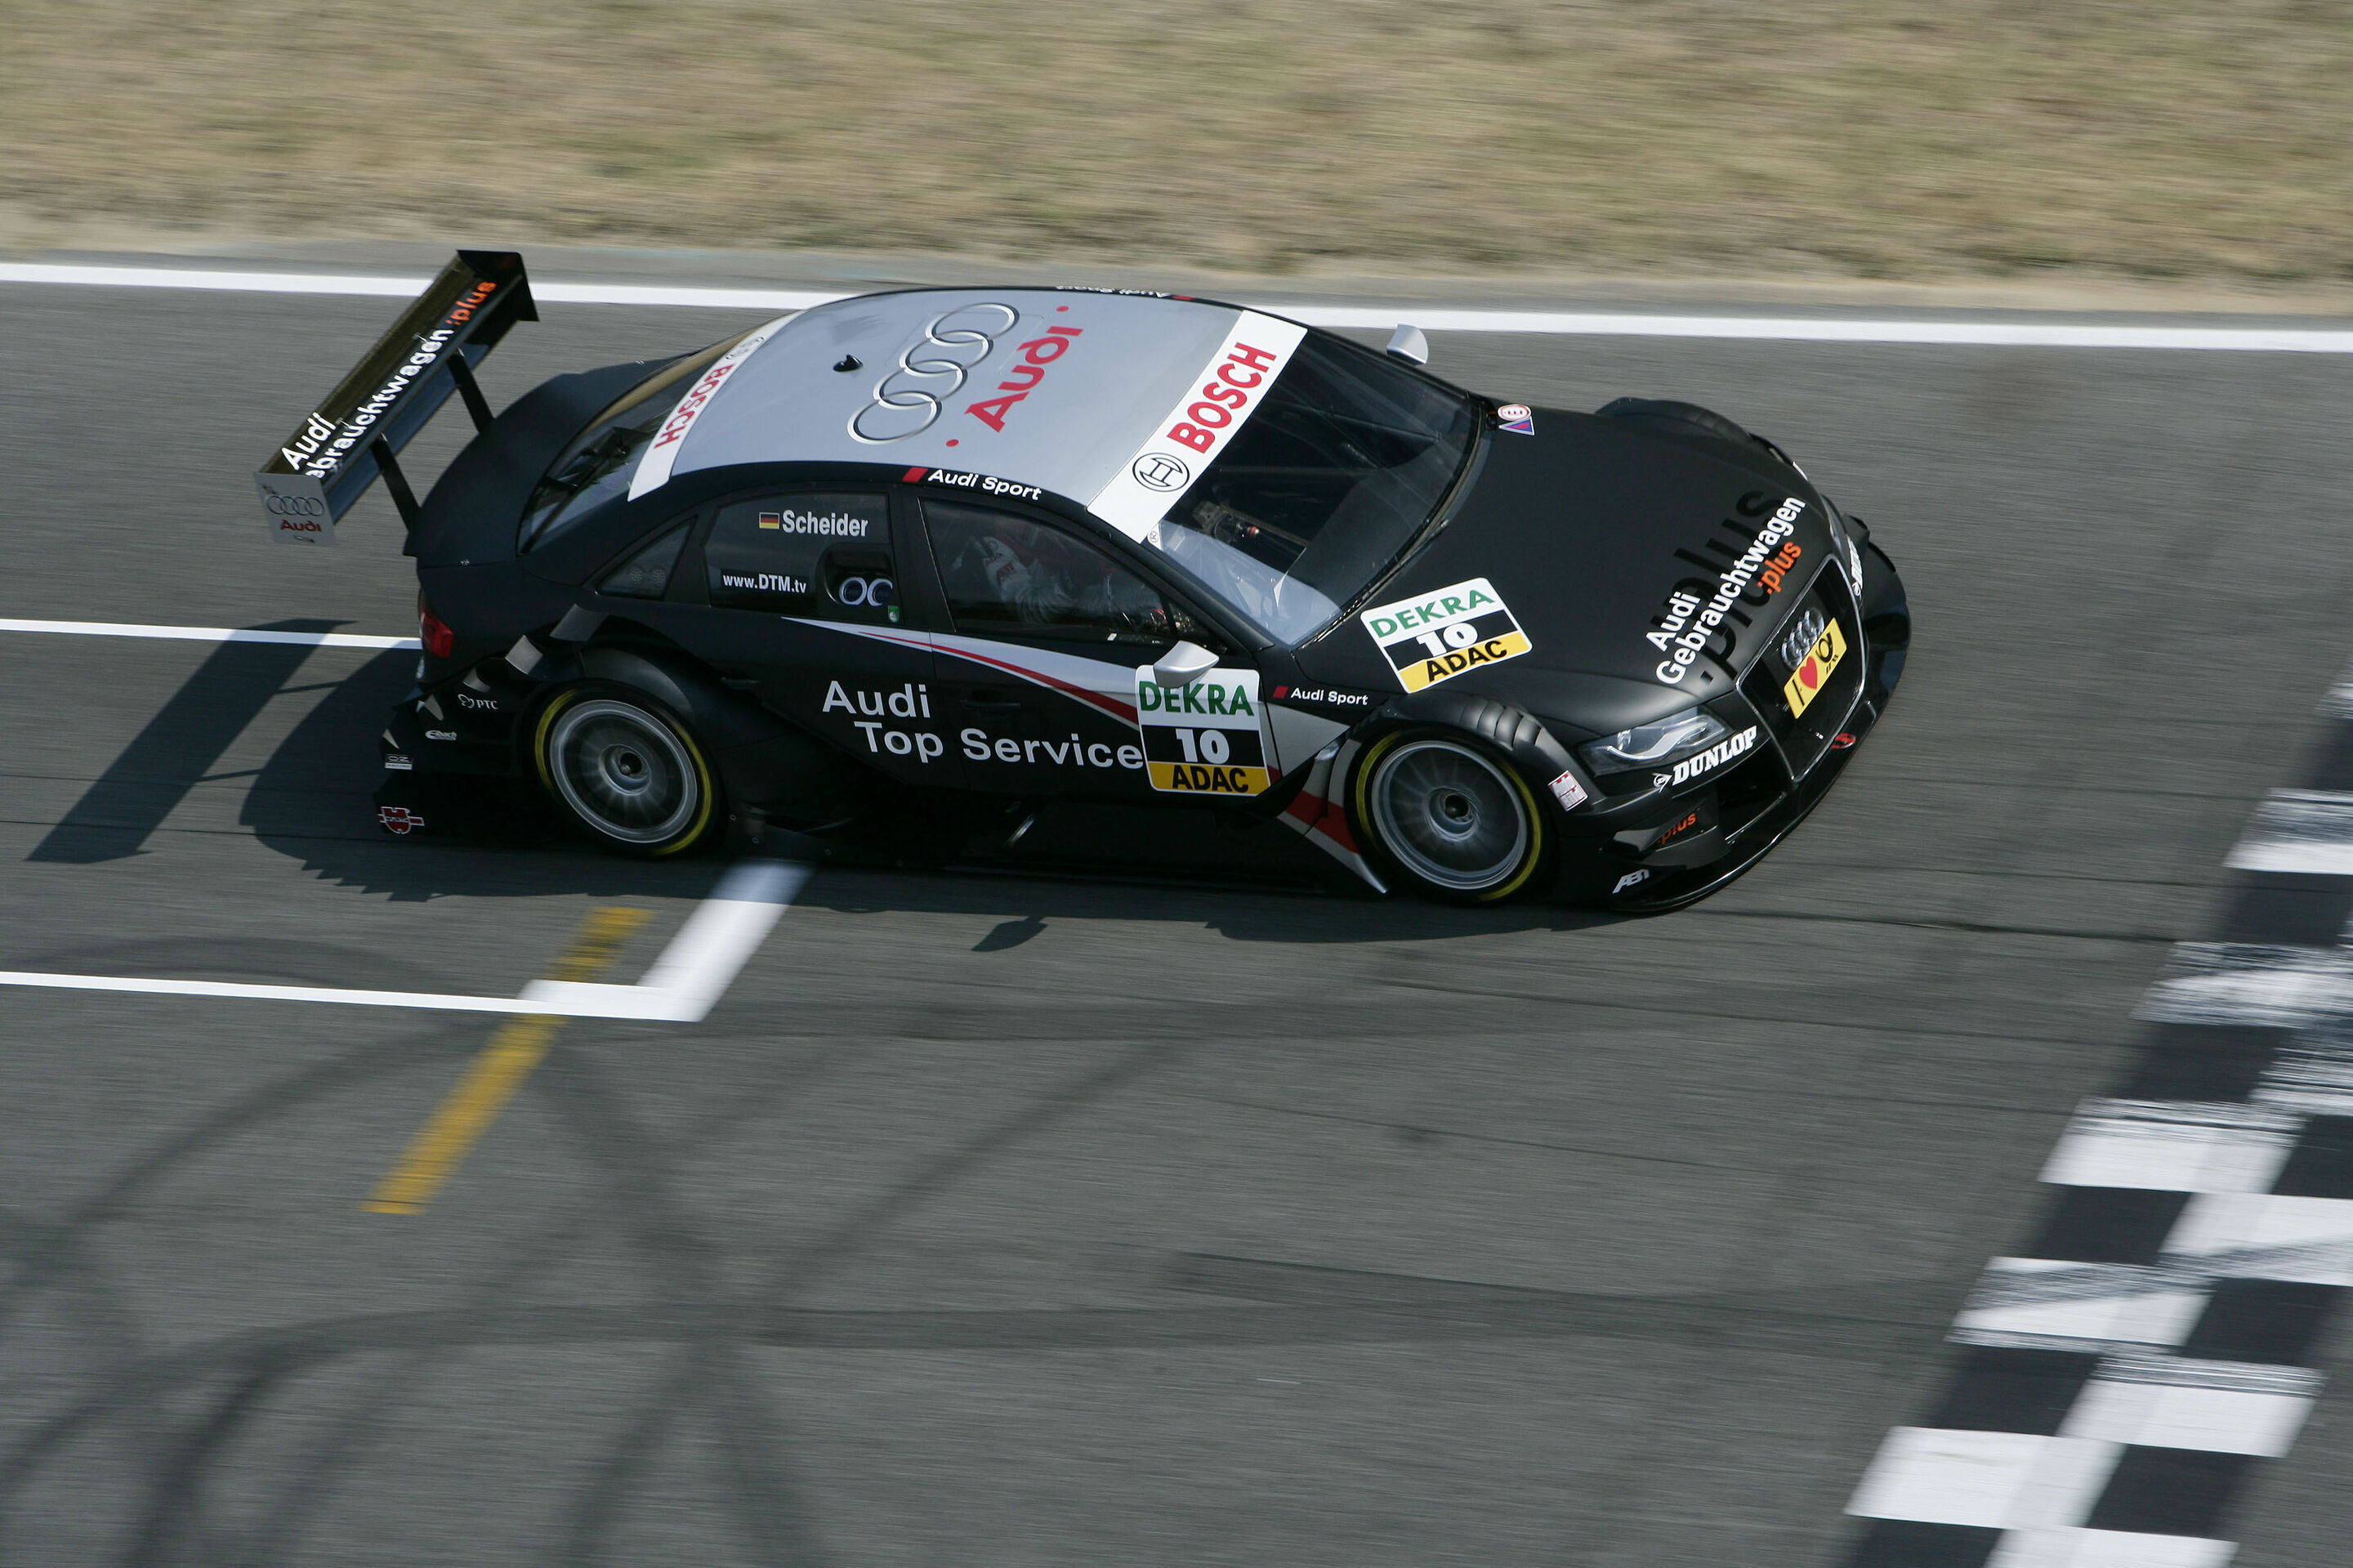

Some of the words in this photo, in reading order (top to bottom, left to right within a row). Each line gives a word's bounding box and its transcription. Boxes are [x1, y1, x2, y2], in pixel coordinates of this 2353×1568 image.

[445, 281, 498, 326] :plus
[964, 325, 1083, 433] Audi
[1167, 342, 1277, 454] BOSCH
[654, 364, 734, 449] BOSCH
[281, 411, 337, 471] Audi
[927, 469, 980, 488] Audi
[982, 476, 1043, 501] Sport
[280, 519, 322, 532] Audi
[782, 509, 869, 537] Scheider
[722, 574, 807, 594] www.DTM.tv
[1756, 541, 1802, 595] :plus
[1655, 496, 1806, 686] Gebrauchtwagen
[1369, 589, 1494, 637] DEKRA
[1645, 591, 1700, 652] Audi
[1416, 622, 1478, 657] 10
[1426, 640, 1507, 682] ADAC
[478, 699, 499, 710] PTC
[822, 680, 931, 719] Audi
[1138, 681, 1254, 717] DEKRA
[1290, 687, 1324, 702] Audi
[1327, 690, 1368, 707] Sport
[854, 721, 944, 763] Top
[960, 727, 1144, 769] Service
[1176, 729, 1230, 766] 10
[1672, 725, 1758, 786] DUNLOP
[1172, 765, 1248, 793] ADAC
